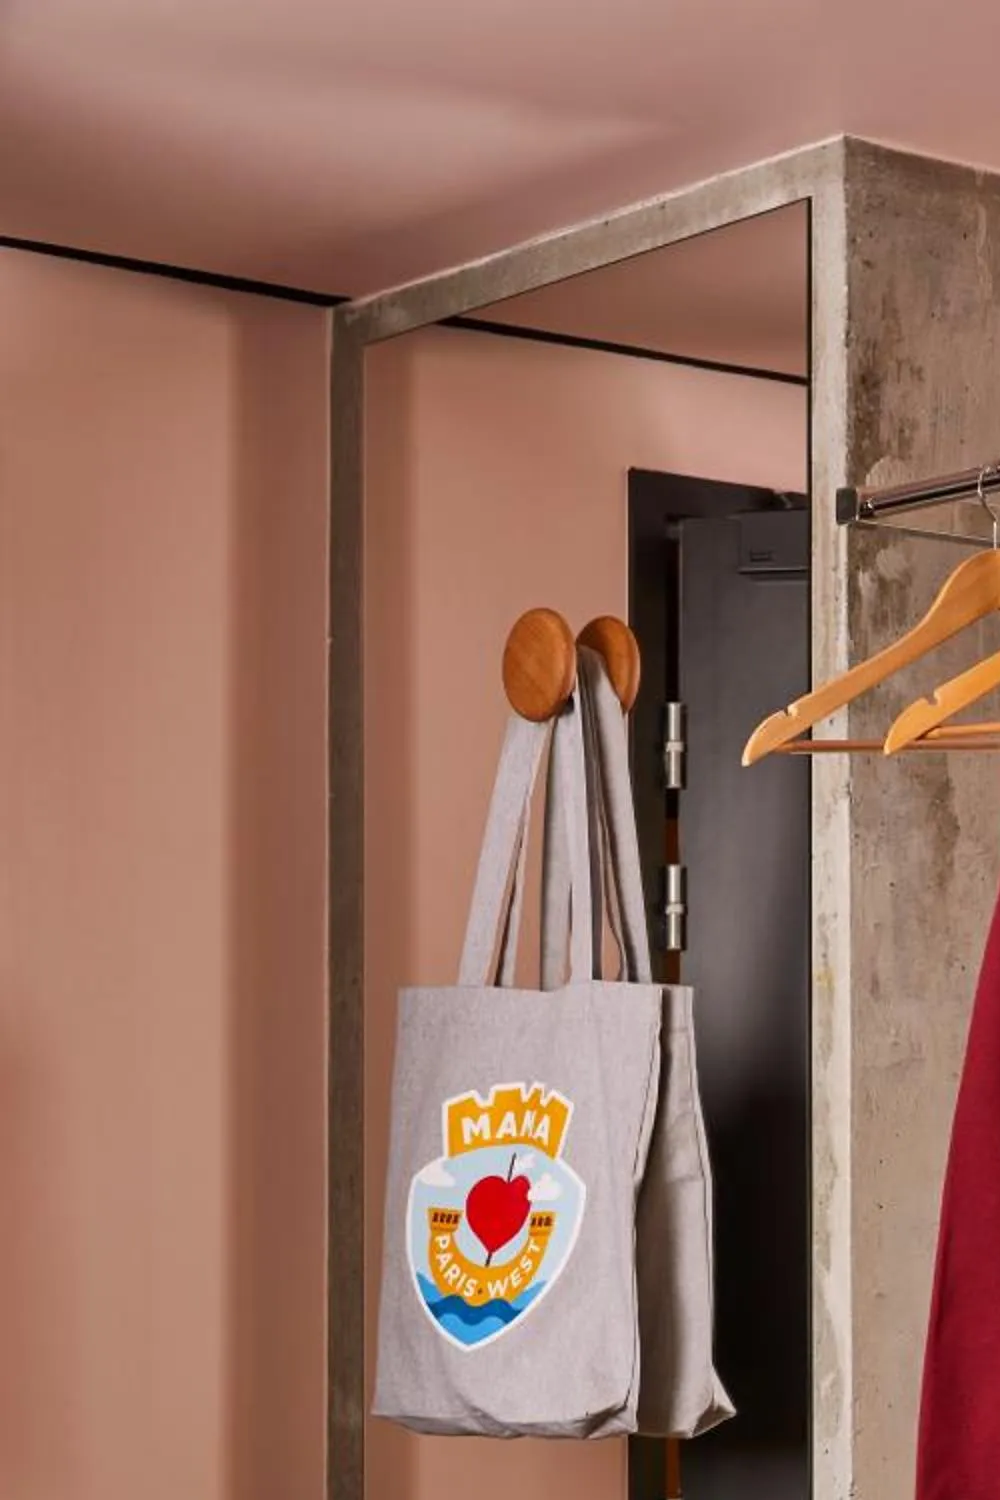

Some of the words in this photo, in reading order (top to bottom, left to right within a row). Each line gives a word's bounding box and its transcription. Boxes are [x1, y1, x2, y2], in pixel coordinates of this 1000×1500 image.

[460, 1110, 550, 1146] MAMA
[433, 1233, 477, 1297] PARIS
[487, 1238, 543, 1298] WEST
